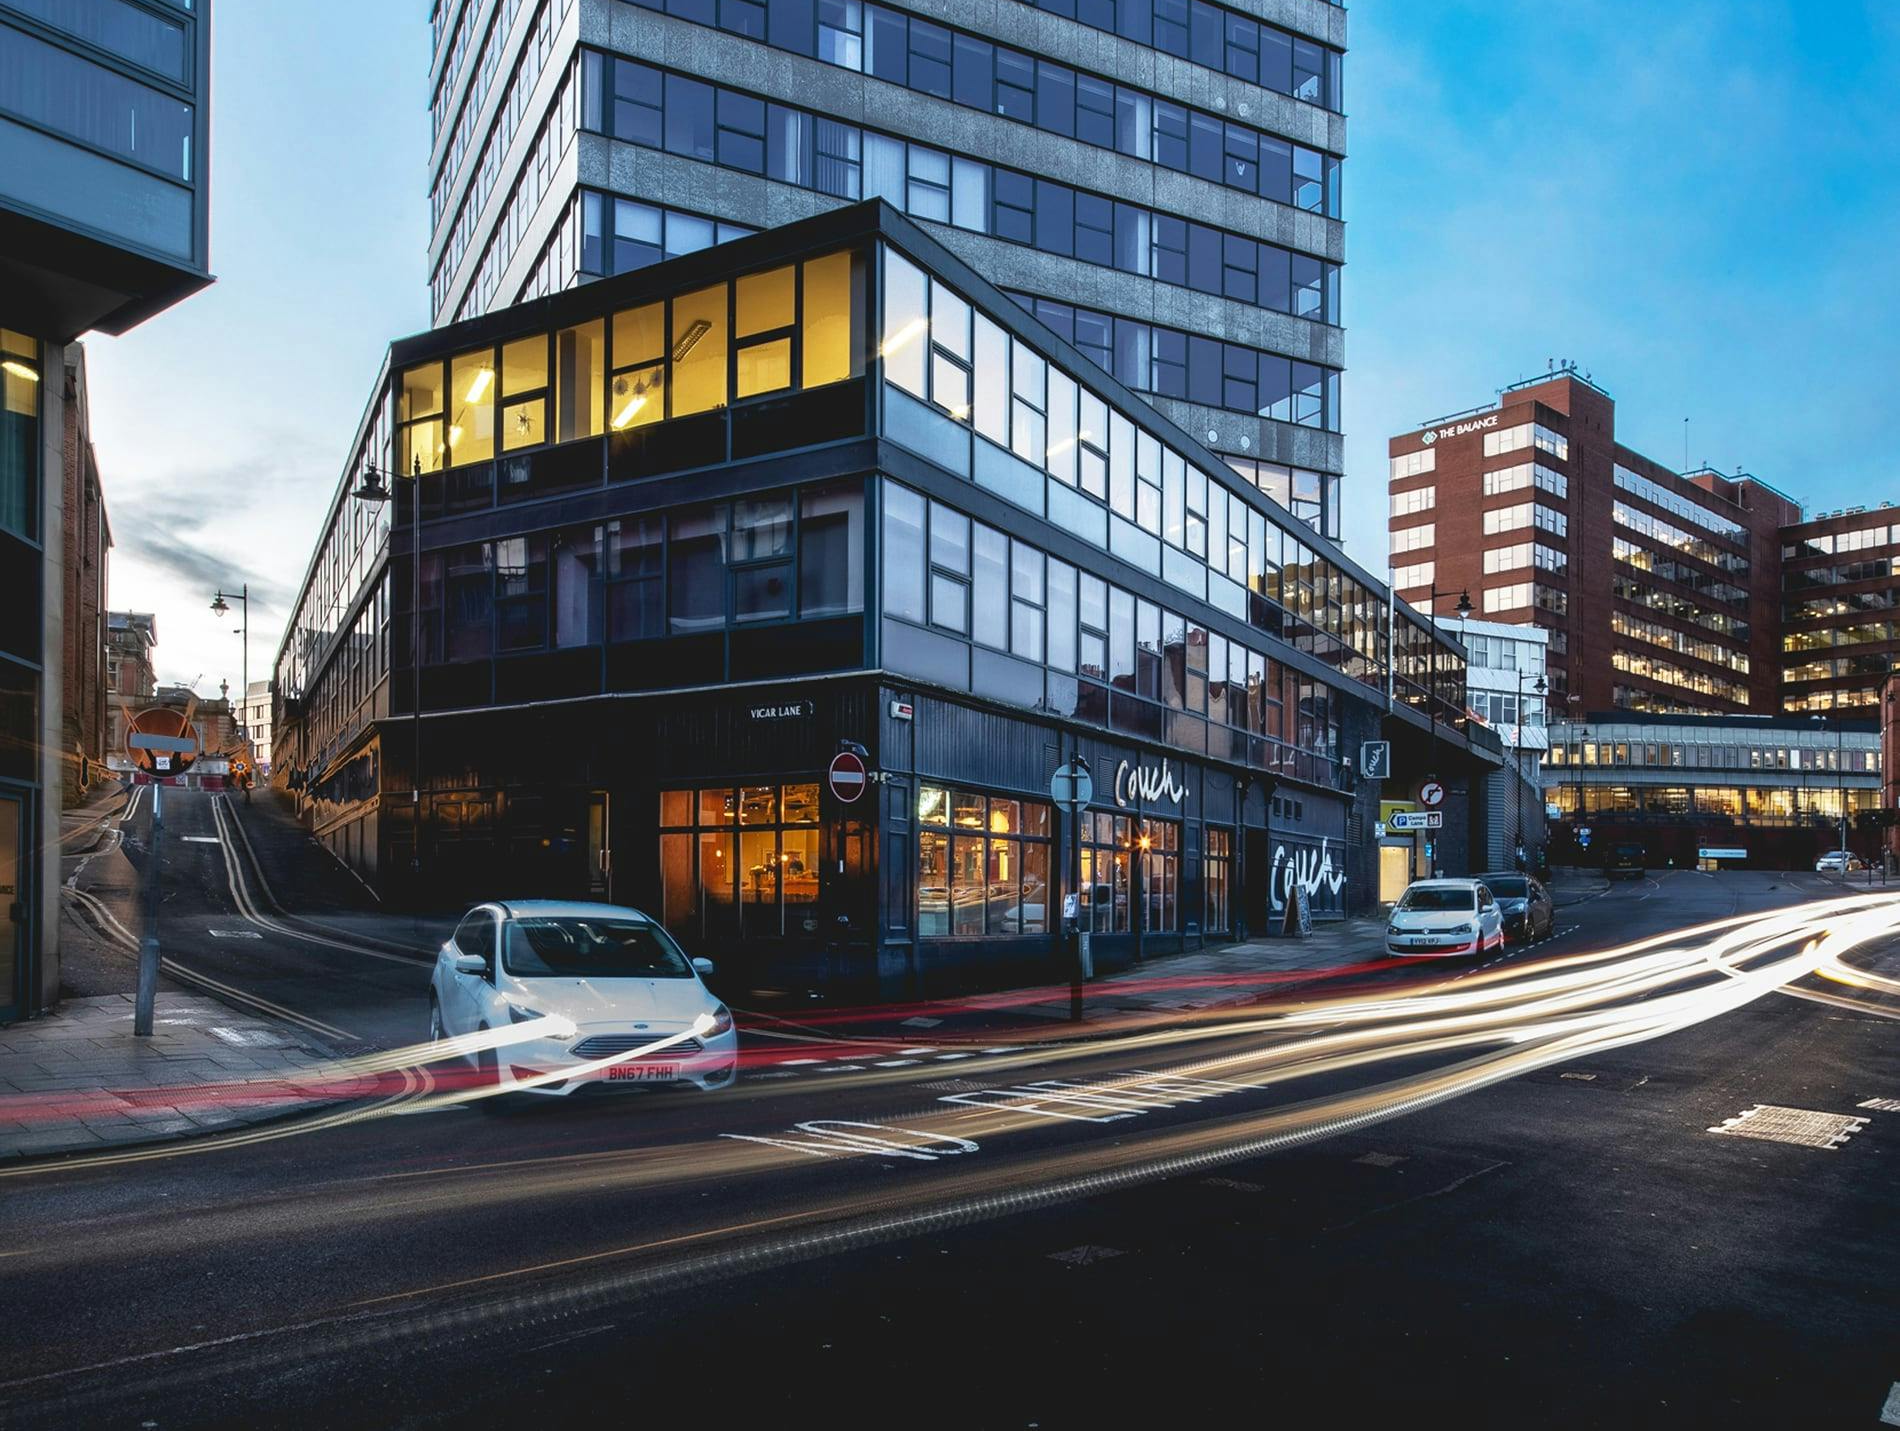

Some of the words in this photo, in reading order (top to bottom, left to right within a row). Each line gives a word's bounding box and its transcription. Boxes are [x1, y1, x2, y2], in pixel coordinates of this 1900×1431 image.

[1440, 427, 1456, 439] THE
[1457, 416, 1498, 435] BALANCE
[750, 708, 777, 718] VICAR
[778, 706, 801, 716] LANE
[609, 1067, 644, 1080] BN67
[647, 1066, 673, 1079] FHH
[719, 1119, 980, 1161] NO
